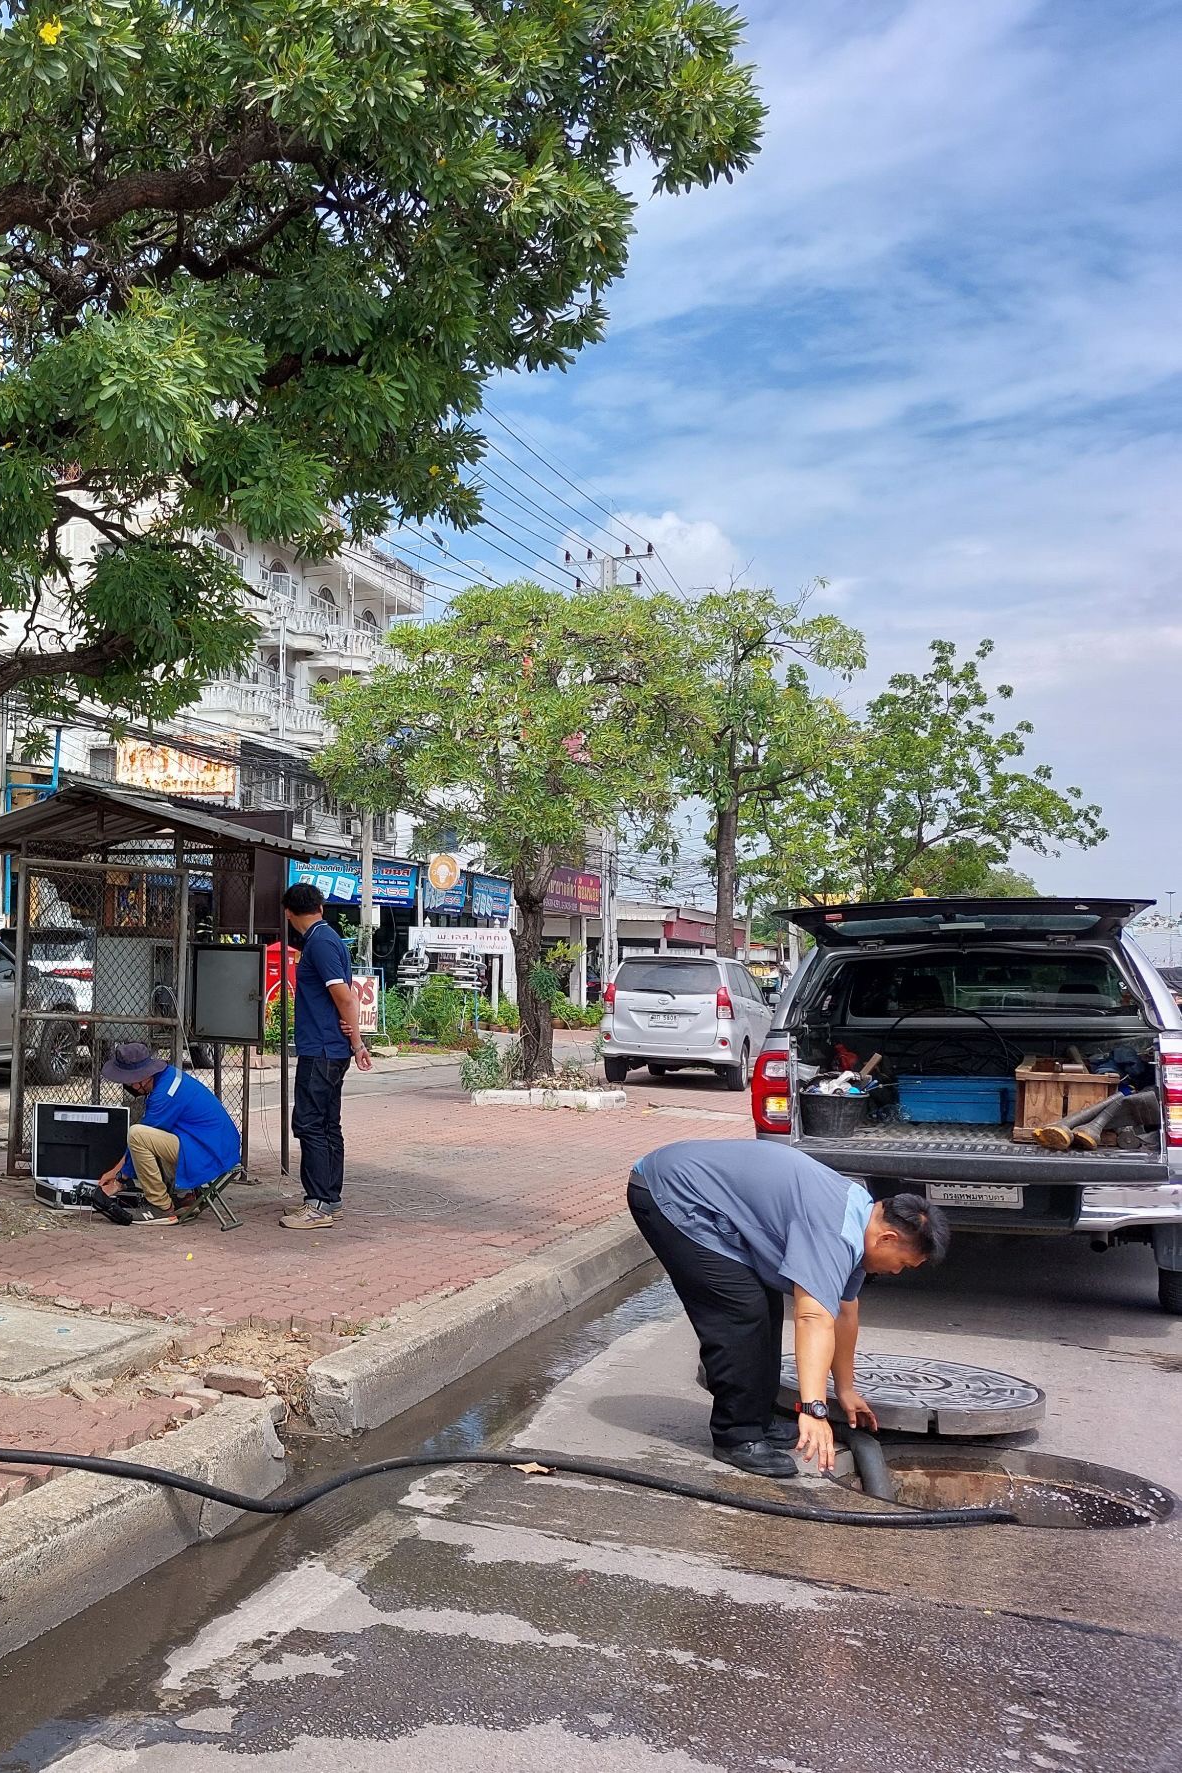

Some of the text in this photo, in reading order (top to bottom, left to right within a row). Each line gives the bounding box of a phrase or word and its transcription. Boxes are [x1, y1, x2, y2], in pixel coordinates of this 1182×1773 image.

[942, 1192, 1005, 1202] กรุงเทพมหานคร
